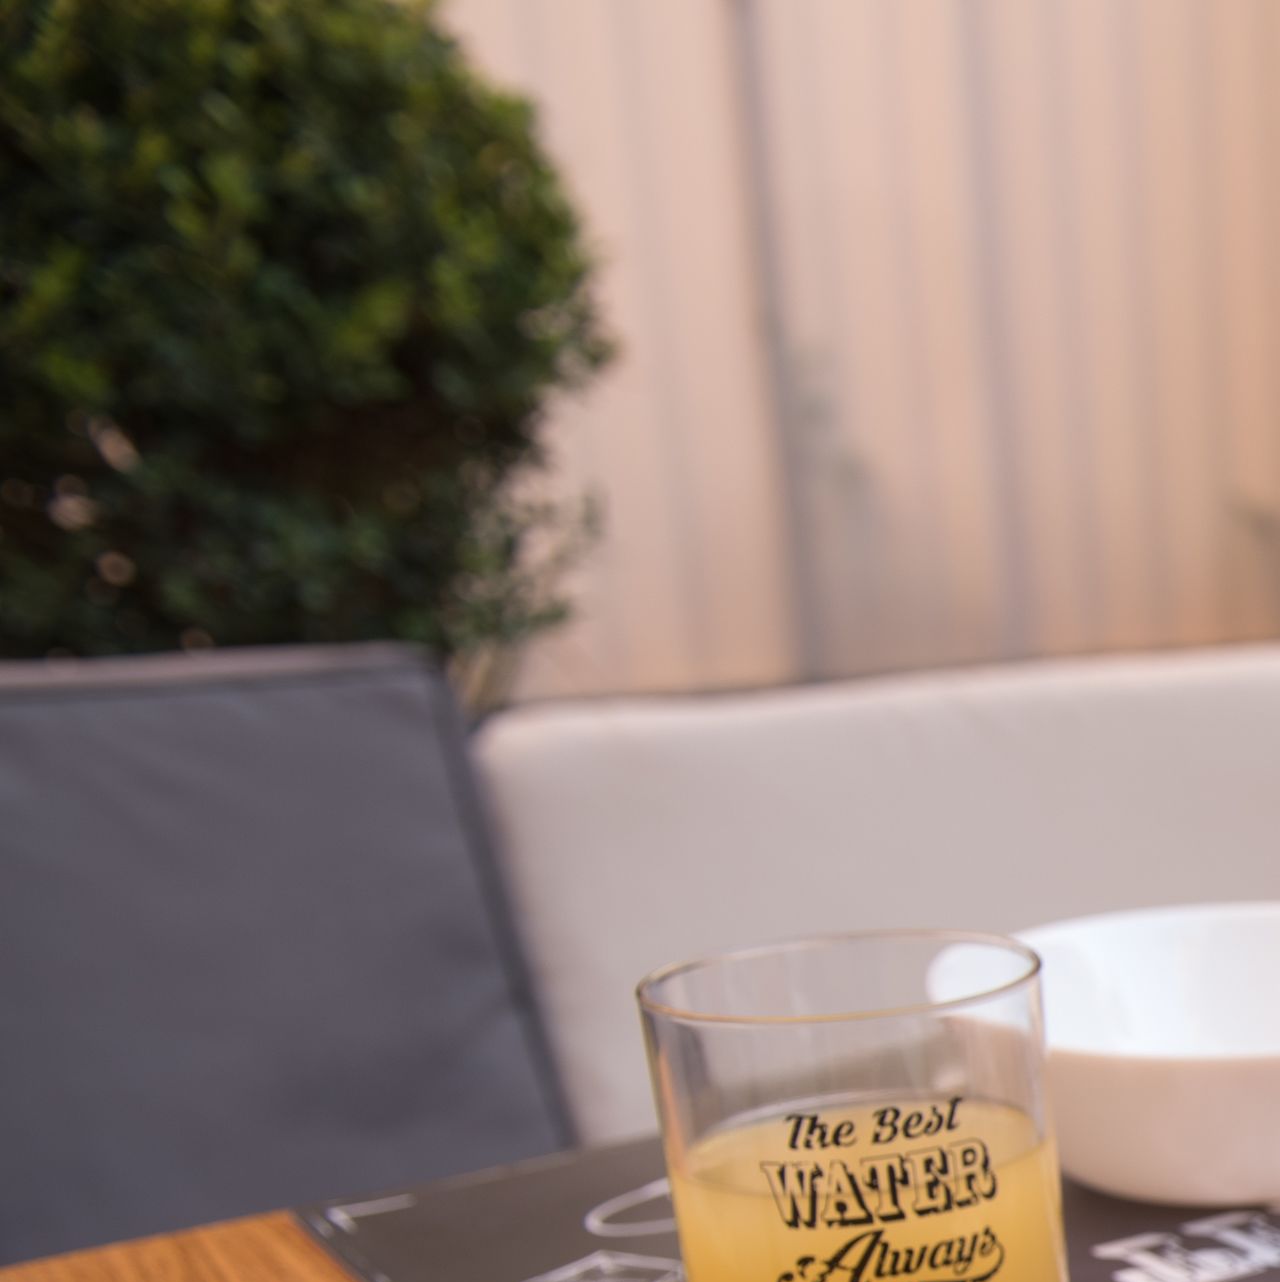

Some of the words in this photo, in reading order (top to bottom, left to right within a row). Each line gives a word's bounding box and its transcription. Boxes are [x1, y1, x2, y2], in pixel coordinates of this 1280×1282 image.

[783, 1113, 858, 1151] The
[872, 1096, 964, 1145] Best
[760, 1138, 998, 1230] WATER
